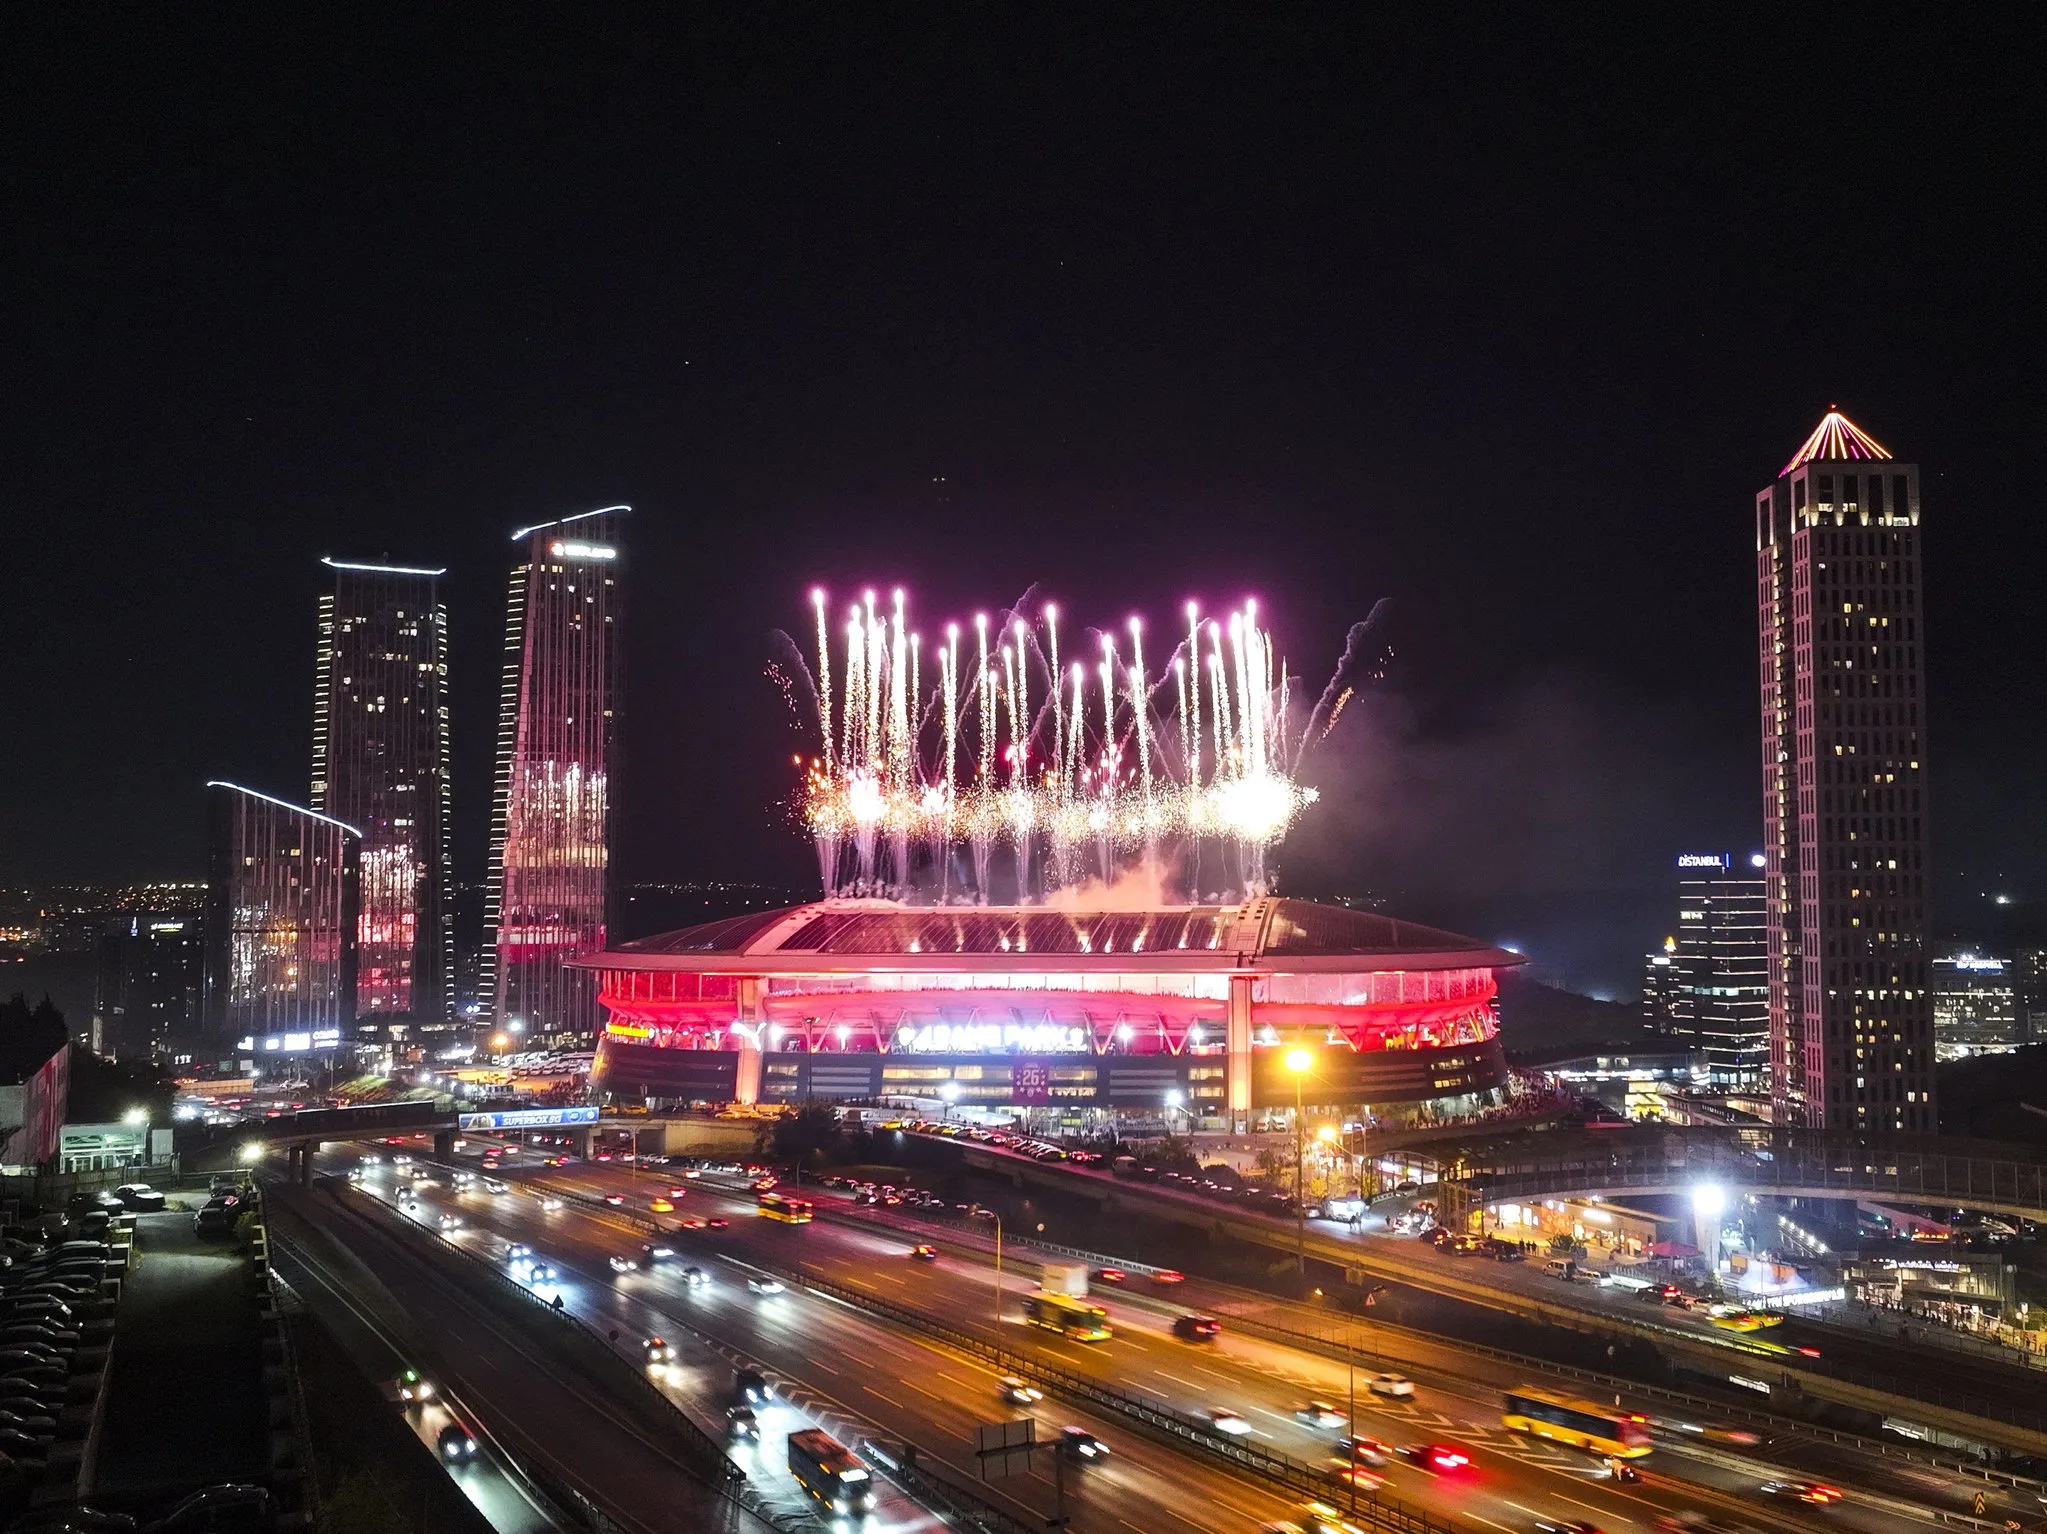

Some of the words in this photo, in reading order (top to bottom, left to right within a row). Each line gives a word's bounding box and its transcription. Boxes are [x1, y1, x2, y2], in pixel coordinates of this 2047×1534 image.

[1022, 1069, 1040, 1086] 26
[503, 1116, 548, 1126] SUPERBOX
[549, 1115, 562, 1124] 5G
